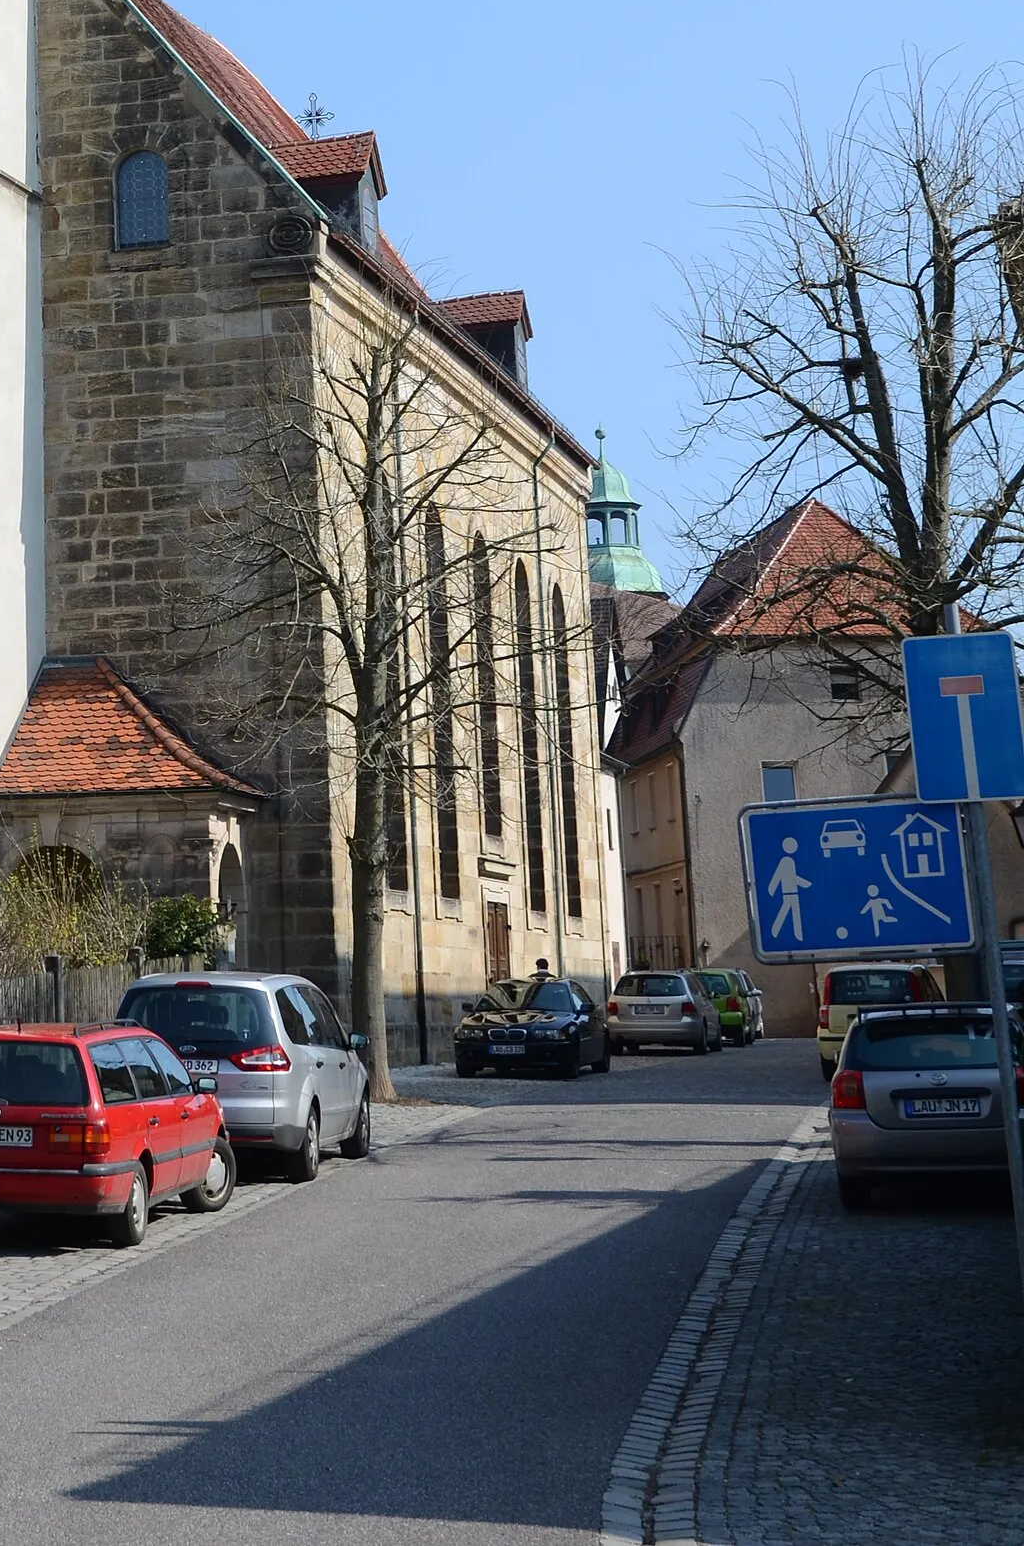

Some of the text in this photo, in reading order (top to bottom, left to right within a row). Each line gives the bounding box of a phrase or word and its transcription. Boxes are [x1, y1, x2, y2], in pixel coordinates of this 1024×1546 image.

[195, 1060, 214, 1071] 362
[912, 1099, 977, 1113] LAU JN 17
[16, 1128, 32, 1142] 93
